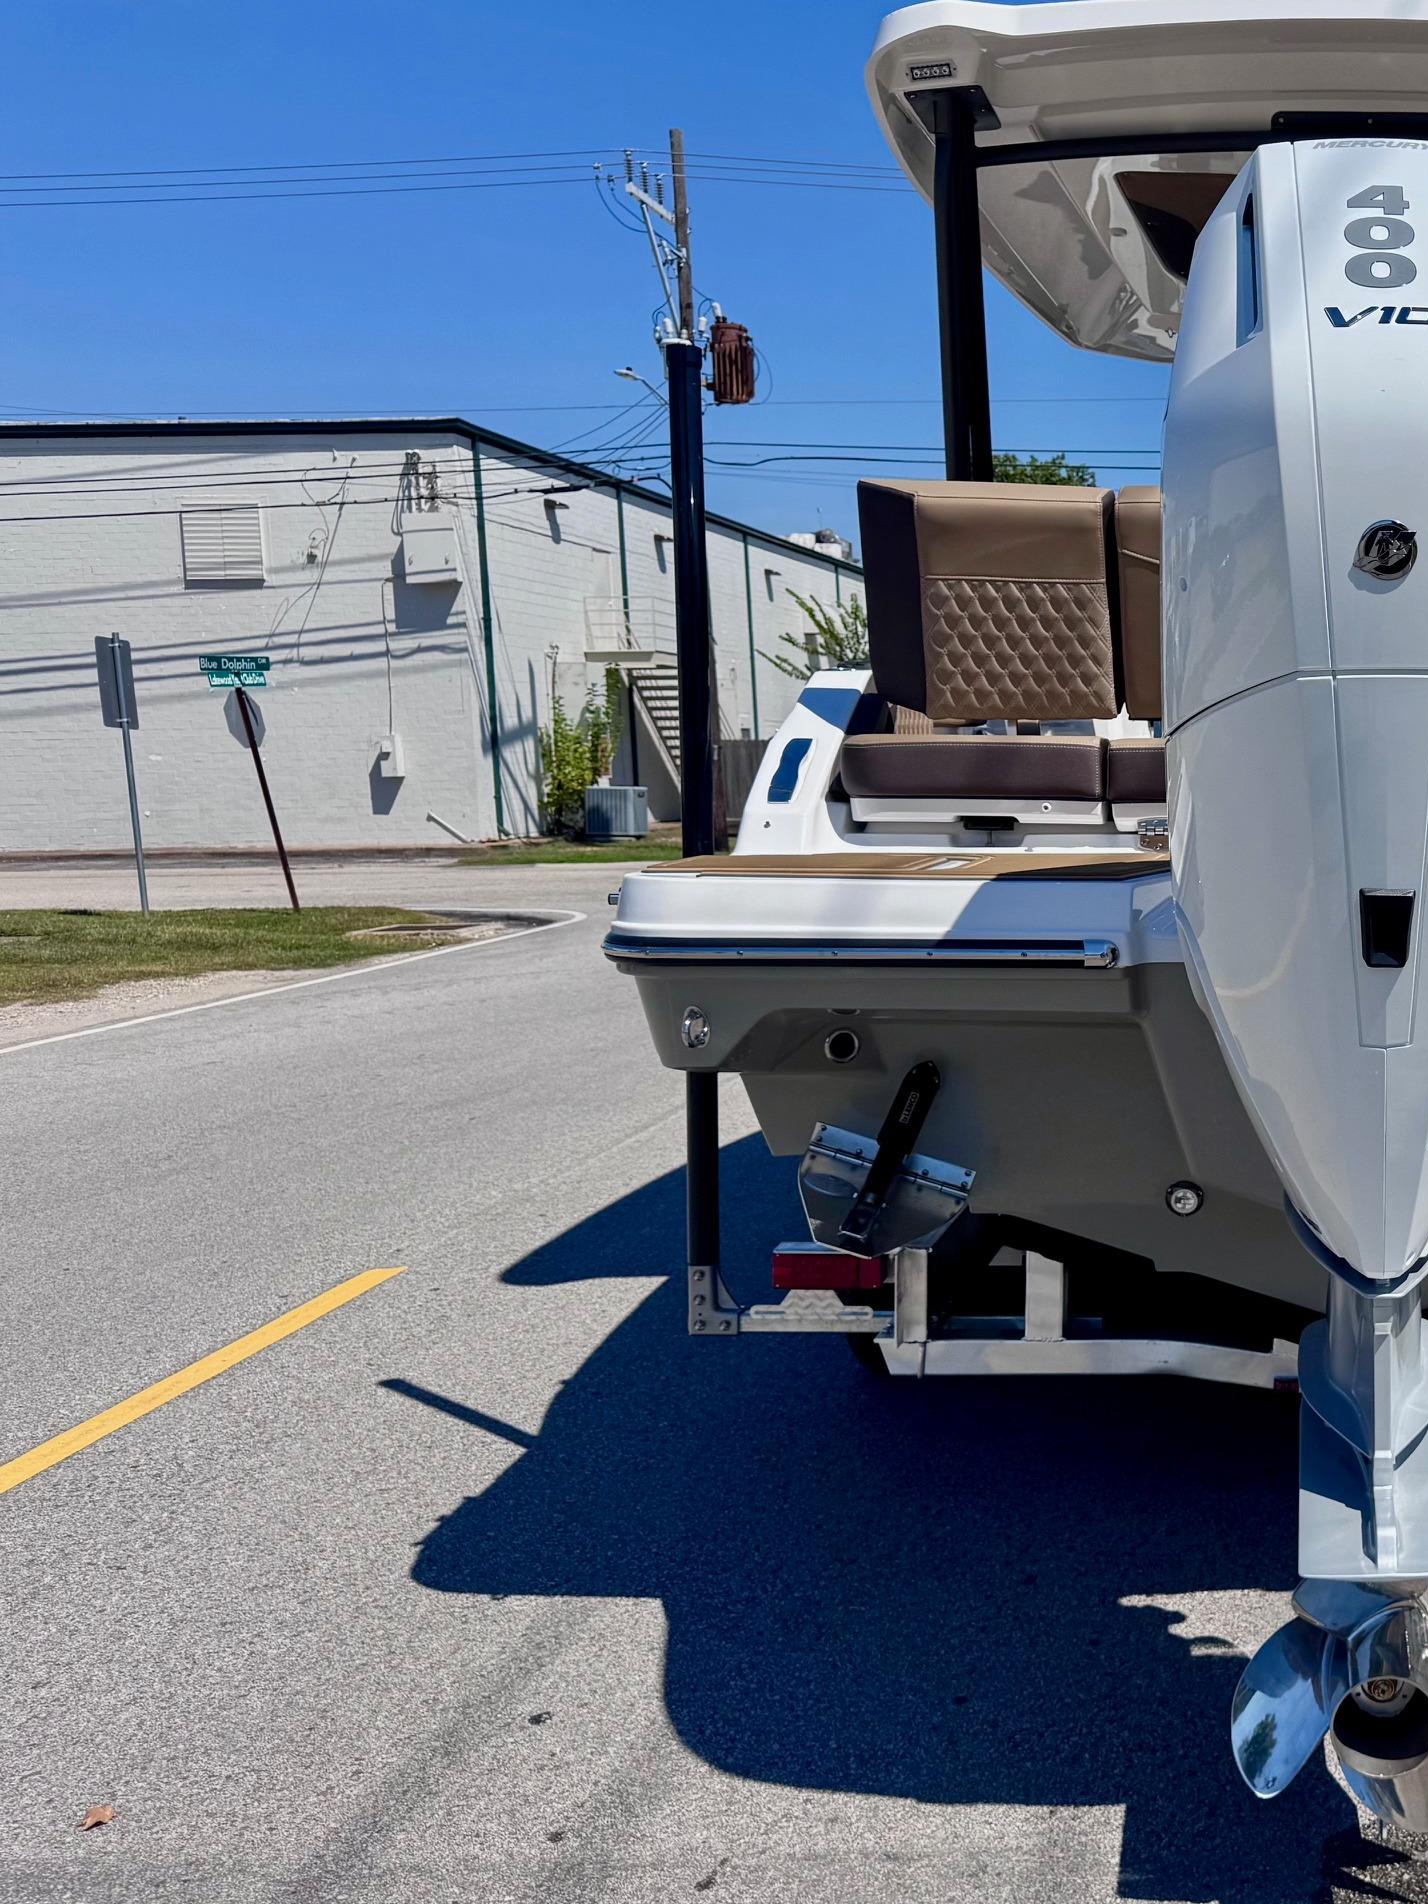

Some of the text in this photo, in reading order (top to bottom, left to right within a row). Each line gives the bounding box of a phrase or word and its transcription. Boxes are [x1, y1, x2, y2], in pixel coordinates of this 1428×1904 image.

[1344, 185, 1417, 288] 400
[200, 658, 218, 669] Blue
[221, 658, 256, 669] Dolphin
